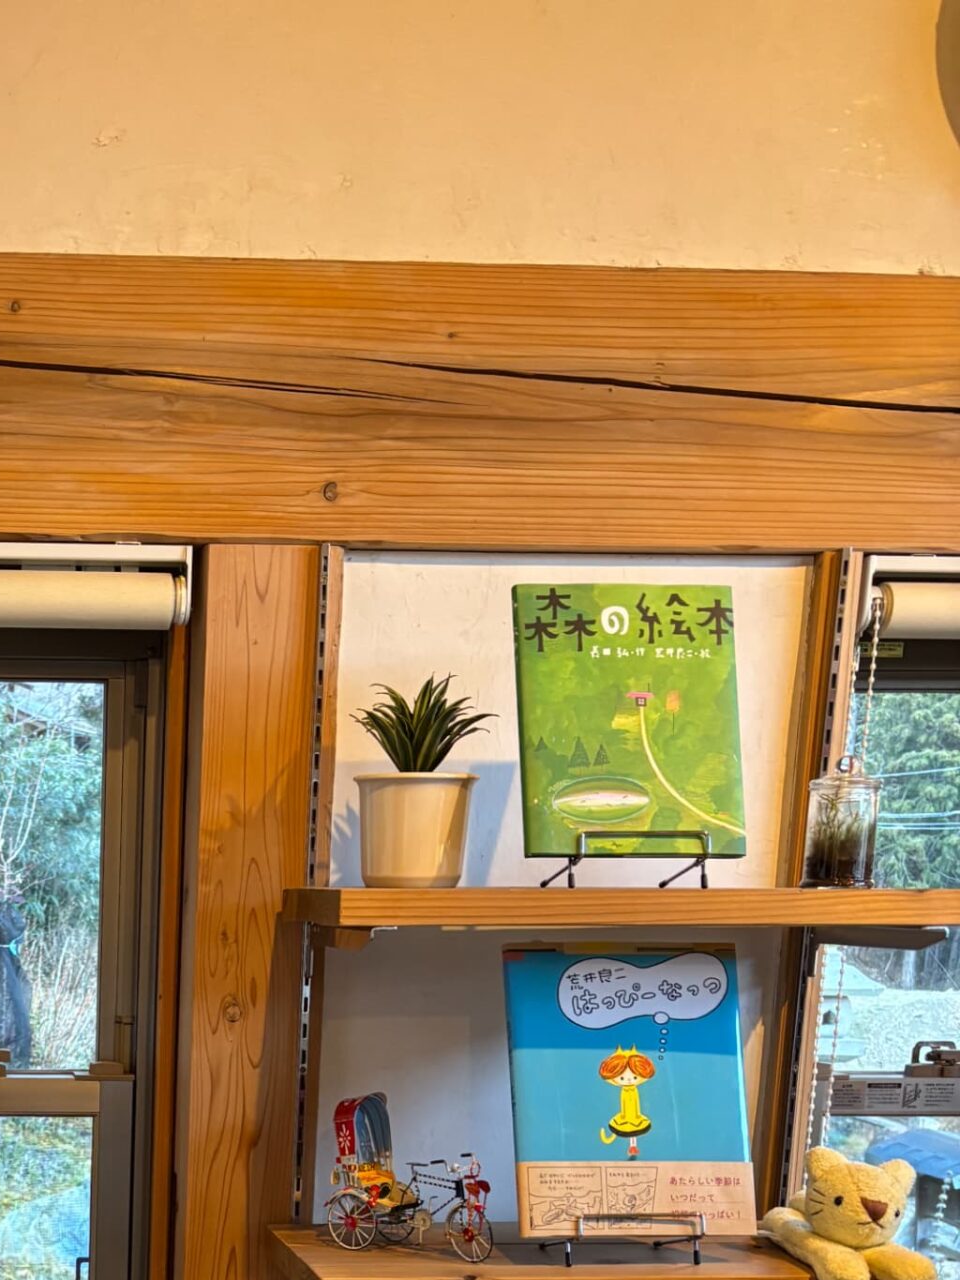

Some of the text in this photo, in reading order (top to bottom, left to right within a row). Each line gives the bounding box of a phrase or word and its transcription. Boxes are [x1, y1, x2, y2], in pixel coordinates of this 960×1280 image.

[525, 588, 734, 652] 森の絵本
[566, 967, 628, 990] 荒井良二
[572, 976, 722, 1017] はっぴーなっつ
[668, 1176, 741, 1187] あたらしい季節は
[670, 1193, 715, 1203] いつだって
